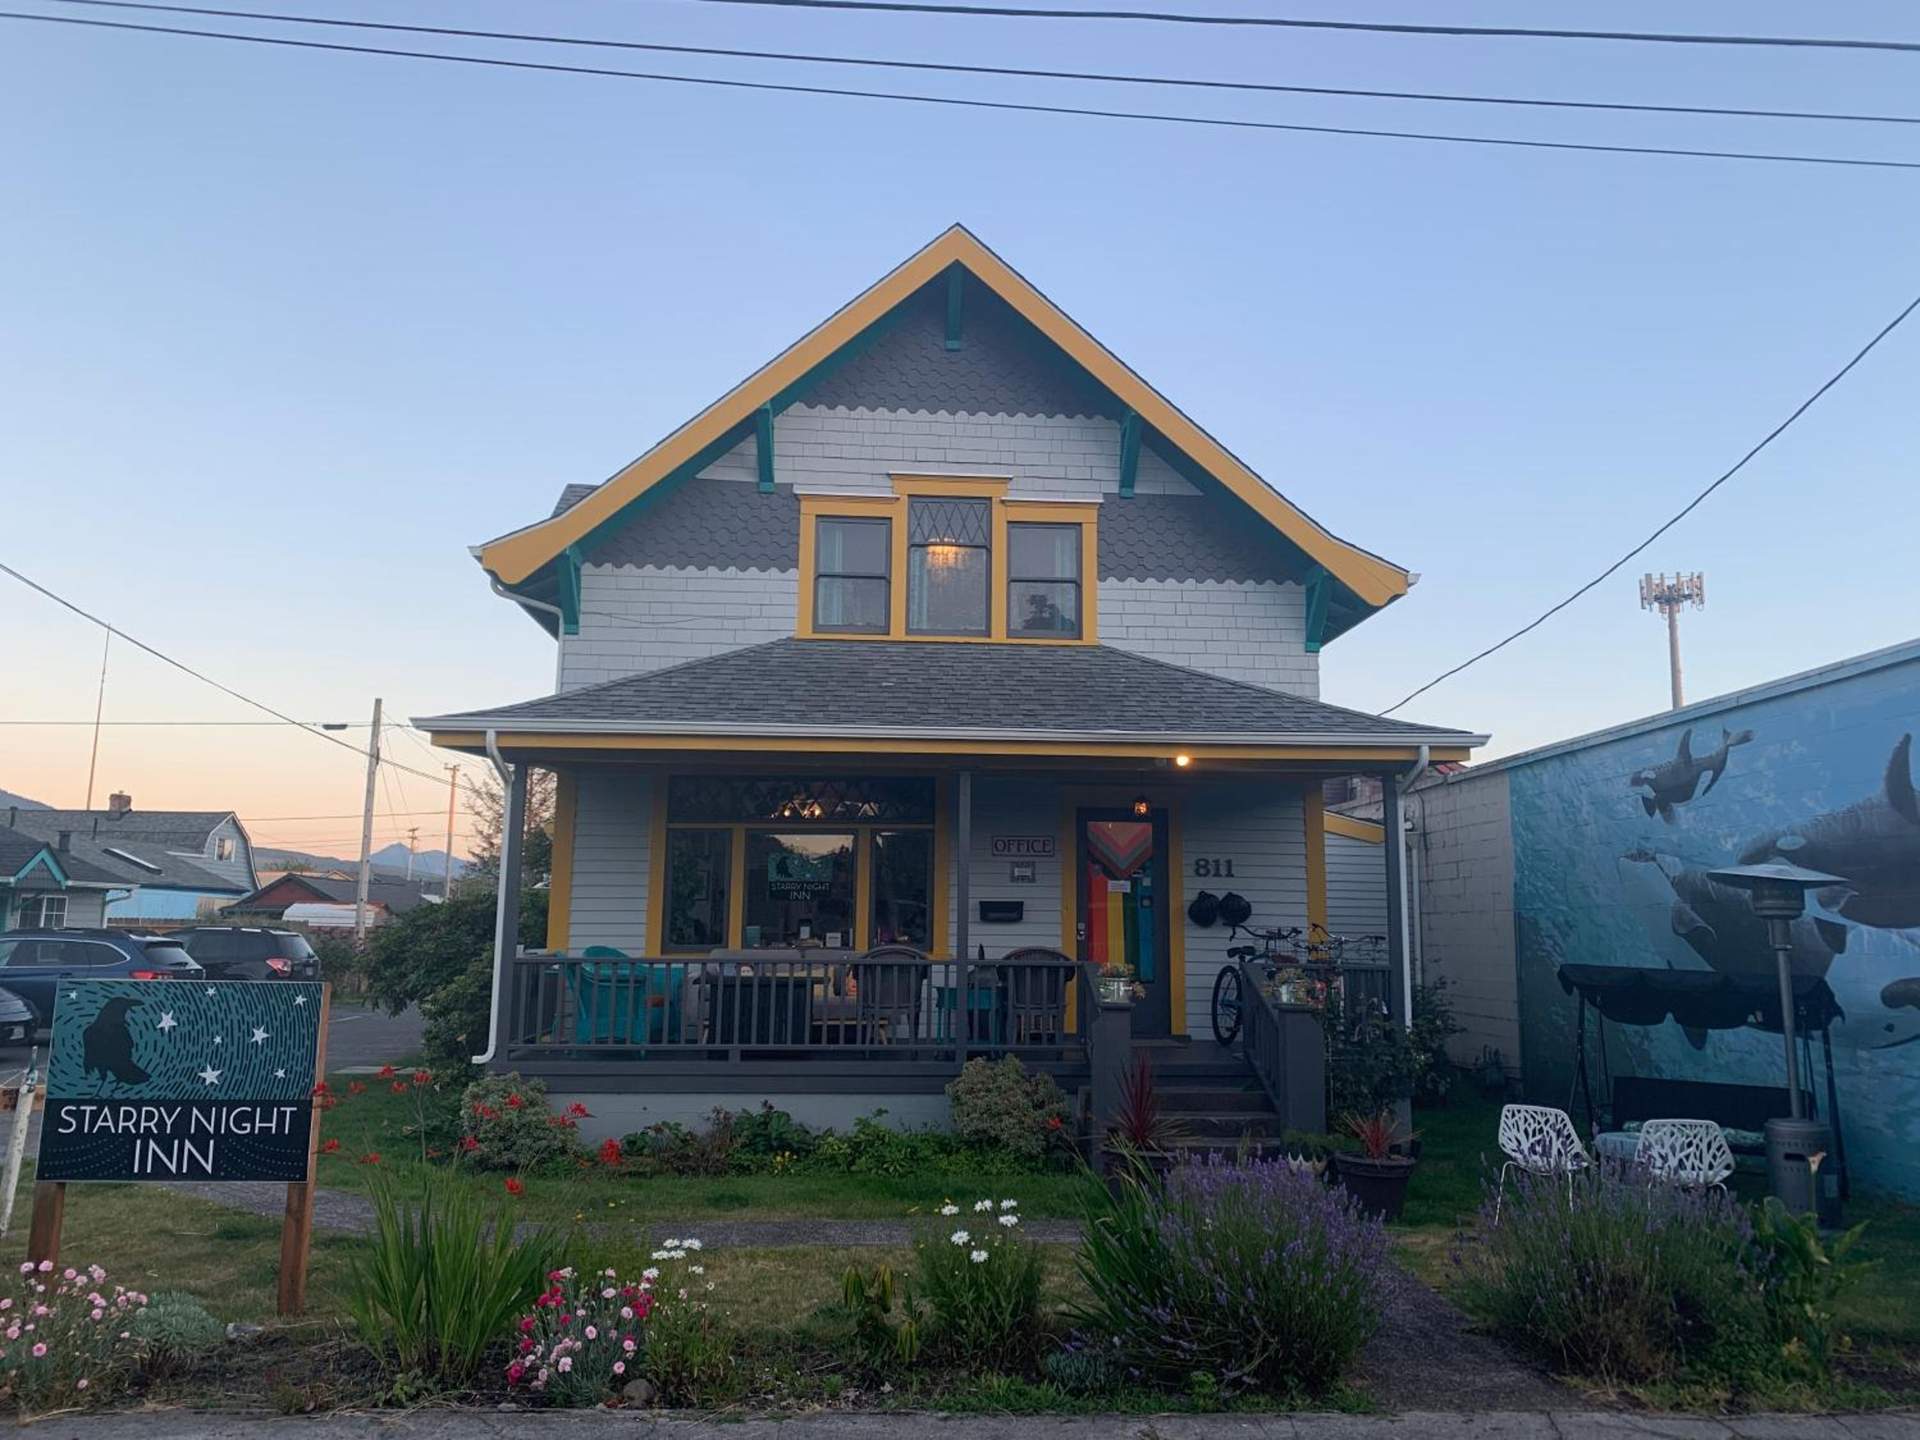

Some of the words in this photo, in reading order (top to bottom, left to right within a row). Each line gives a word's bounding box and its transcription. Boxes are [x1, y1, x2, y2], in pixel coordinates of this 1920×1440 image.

[994, 839, 1051, 854] OFFICE
[1194, 858, 1235, 877] 811
[771, 882, 800, 890] STARRY
[803, 882, 830, 890] NIGHT
[790, 891, 811, 900] INN
[58, 1106, 181, 1134] STARRY
[190, 1106, 297, 1135] NIGHT
[133, 1139, 214, 1174] INN
